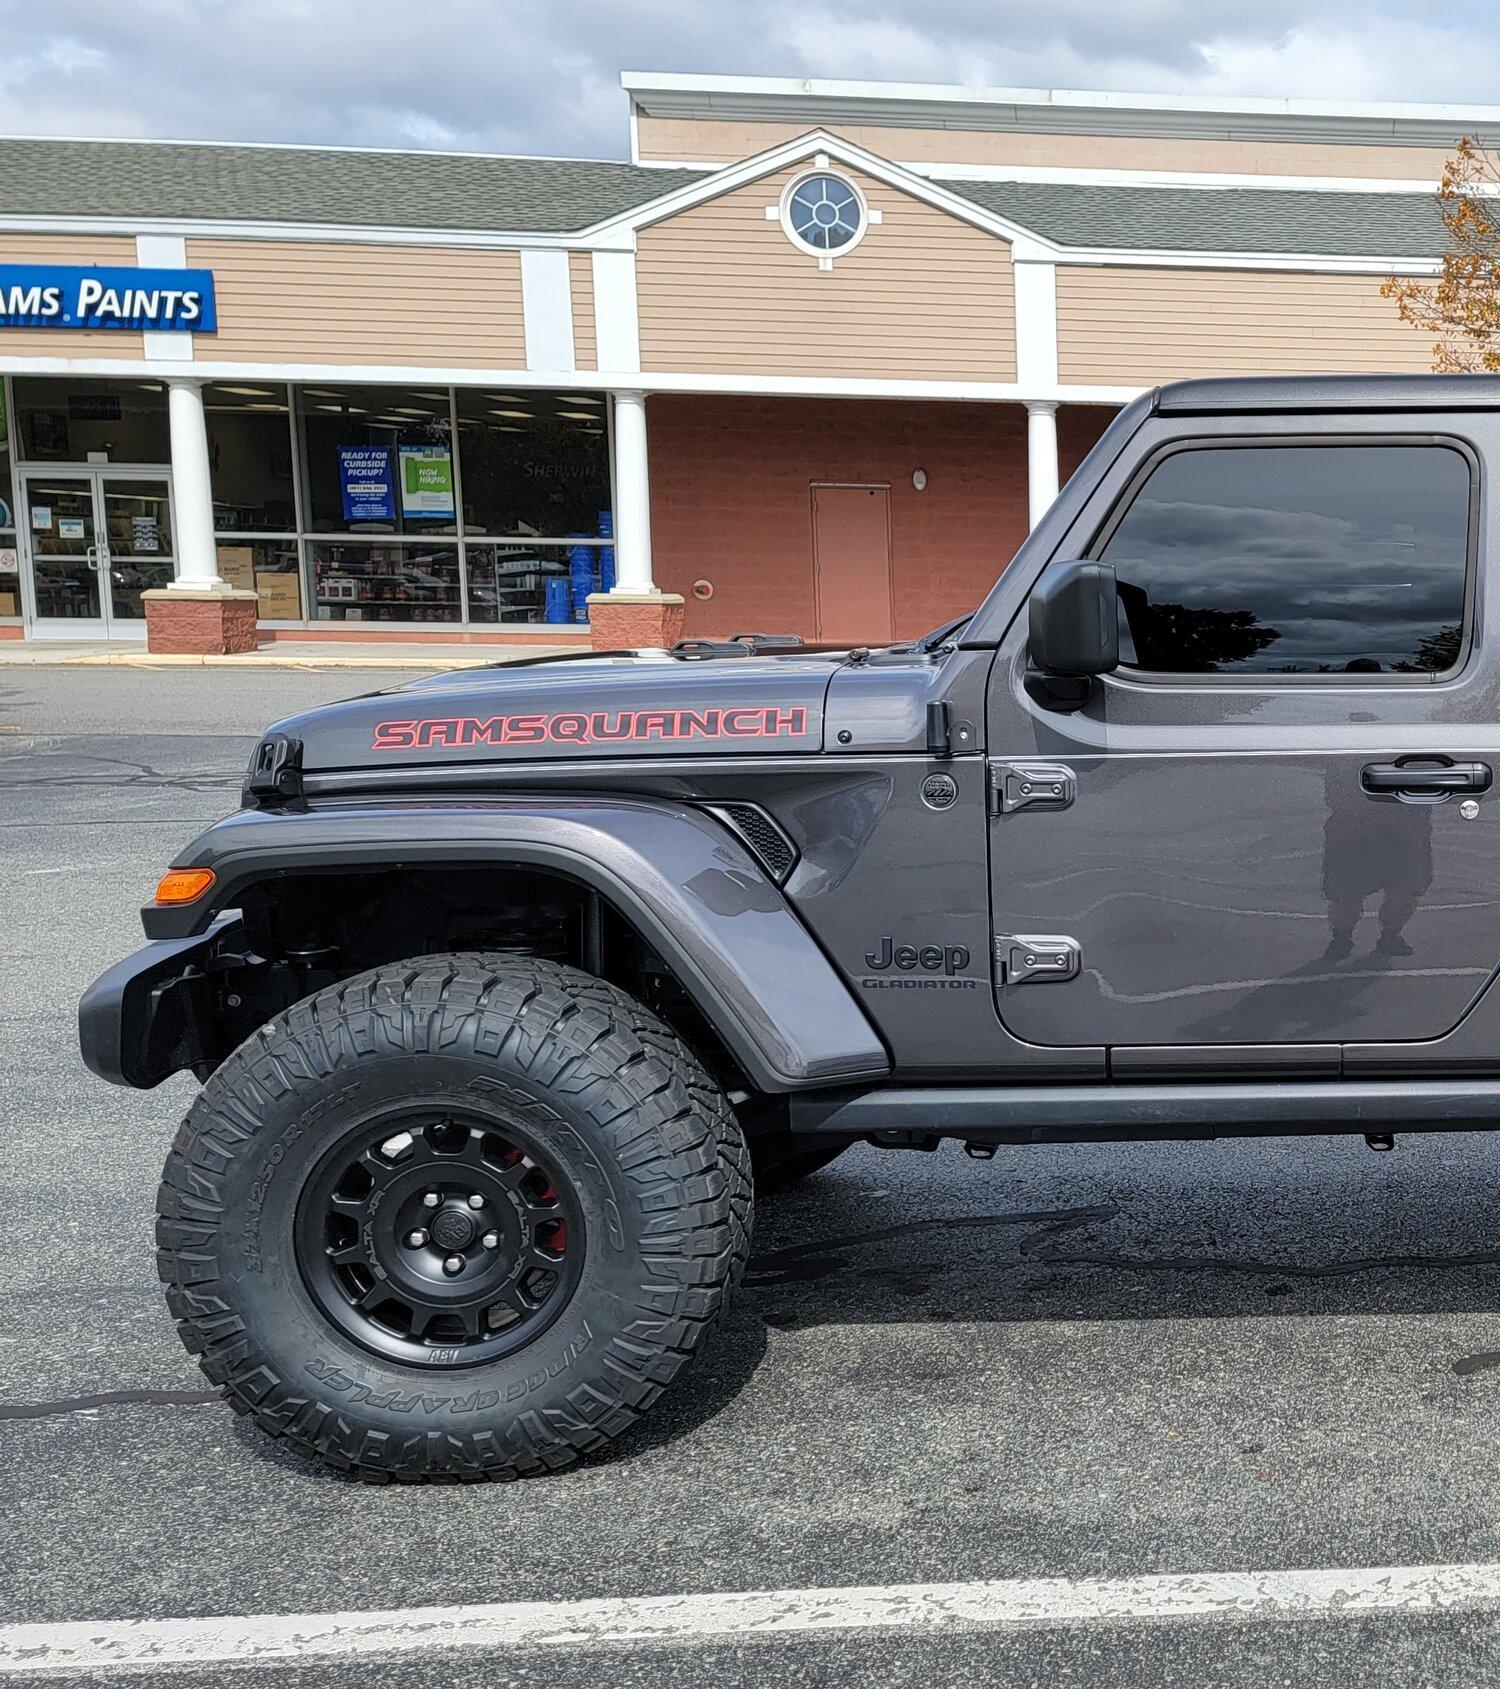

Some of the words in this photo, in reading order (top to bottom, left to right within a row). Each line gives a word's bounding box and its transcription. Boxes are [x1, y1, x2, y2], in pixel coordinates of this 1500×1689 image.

[76, 278, 199, 320] PAINTS
[341, 451, 370, 460] READY
[371, 451, 388, 460] FOR
[344, 459, 387, 468] CURBSIDE
[347, 468, 384, 477] PICKUP?
[419, 468, 438, 476] NOW
[419, 475, 447, 484] HIRING
[370, 705, 808, 751] SAMSQUANCH
[865, 936, 970, 976] Jeep
[862, 978, 977, 990] GLADIATOR
